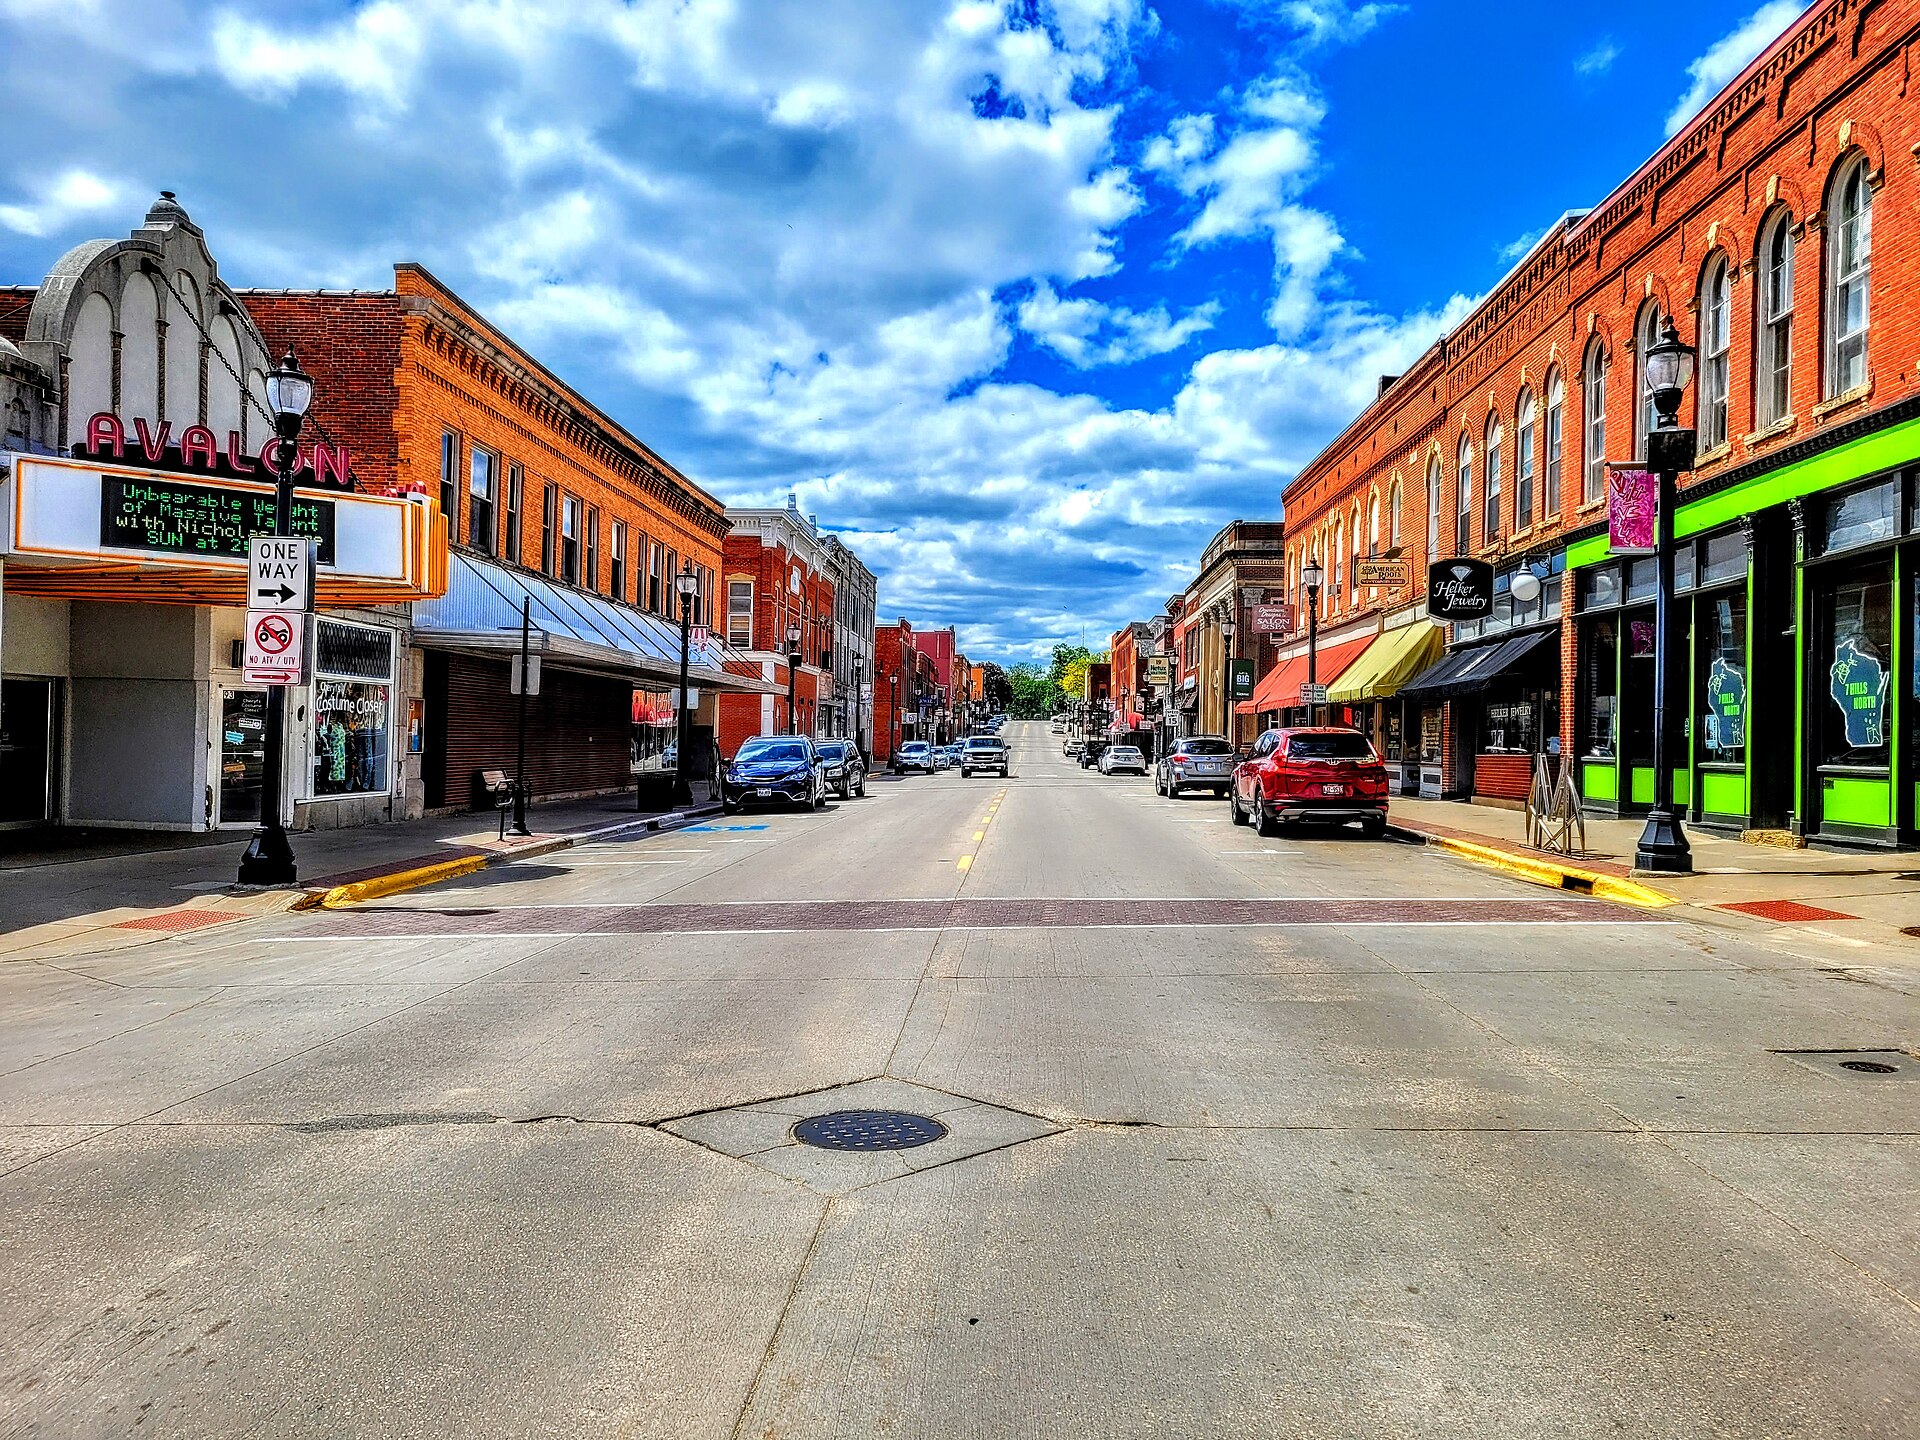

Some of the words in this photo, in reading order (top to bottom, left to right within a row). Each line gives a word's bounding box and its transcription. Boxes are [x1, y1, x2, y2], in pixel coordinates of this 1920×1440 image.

[86, 412, 350, 485] AVALON
[122, 483, 242, 510] Unbearable
[253, 498, 319, 518] Weght
[116, 515, 165, 530] with
[122, 501, 147, 514] of
[160, 503, 242, 522] Massive
[254, 513, 318, 532] Taent
[147, 530, 184, 547] SUN
[195, 535, 219, 550] at
[260, 543, 298, 559] ONE
[258, 563, 299, 579] WAY
[1373, 565, 1404, 574] AMERICAN
[1379, 571, 1401, 580] ROOTS
[1433, 580, 1475, 597] Helker
[1442, 594, 1487, 611] Jewelry
[249, 655, 259, 664] NO
[261, 655, 273, 665] ATV
[283, 656, 296, 666] UTV
[1236, 674, 1250, 683] BIG
[1845, 683, 1849, 696] 7
[1850, 681, 1868, 695] HILLS
[315, 696, 355, 714] Costume
[357, 697, 383, 715] Closet
[1718, 694, 1722, 704] 7
[1853, 696, 1876, 710] NORTH
[1490, 708, 1508, 718] HELKER
[1510, 706, 1532, 718] JEWELRY
[1169, 717, 1178, 725] 15
